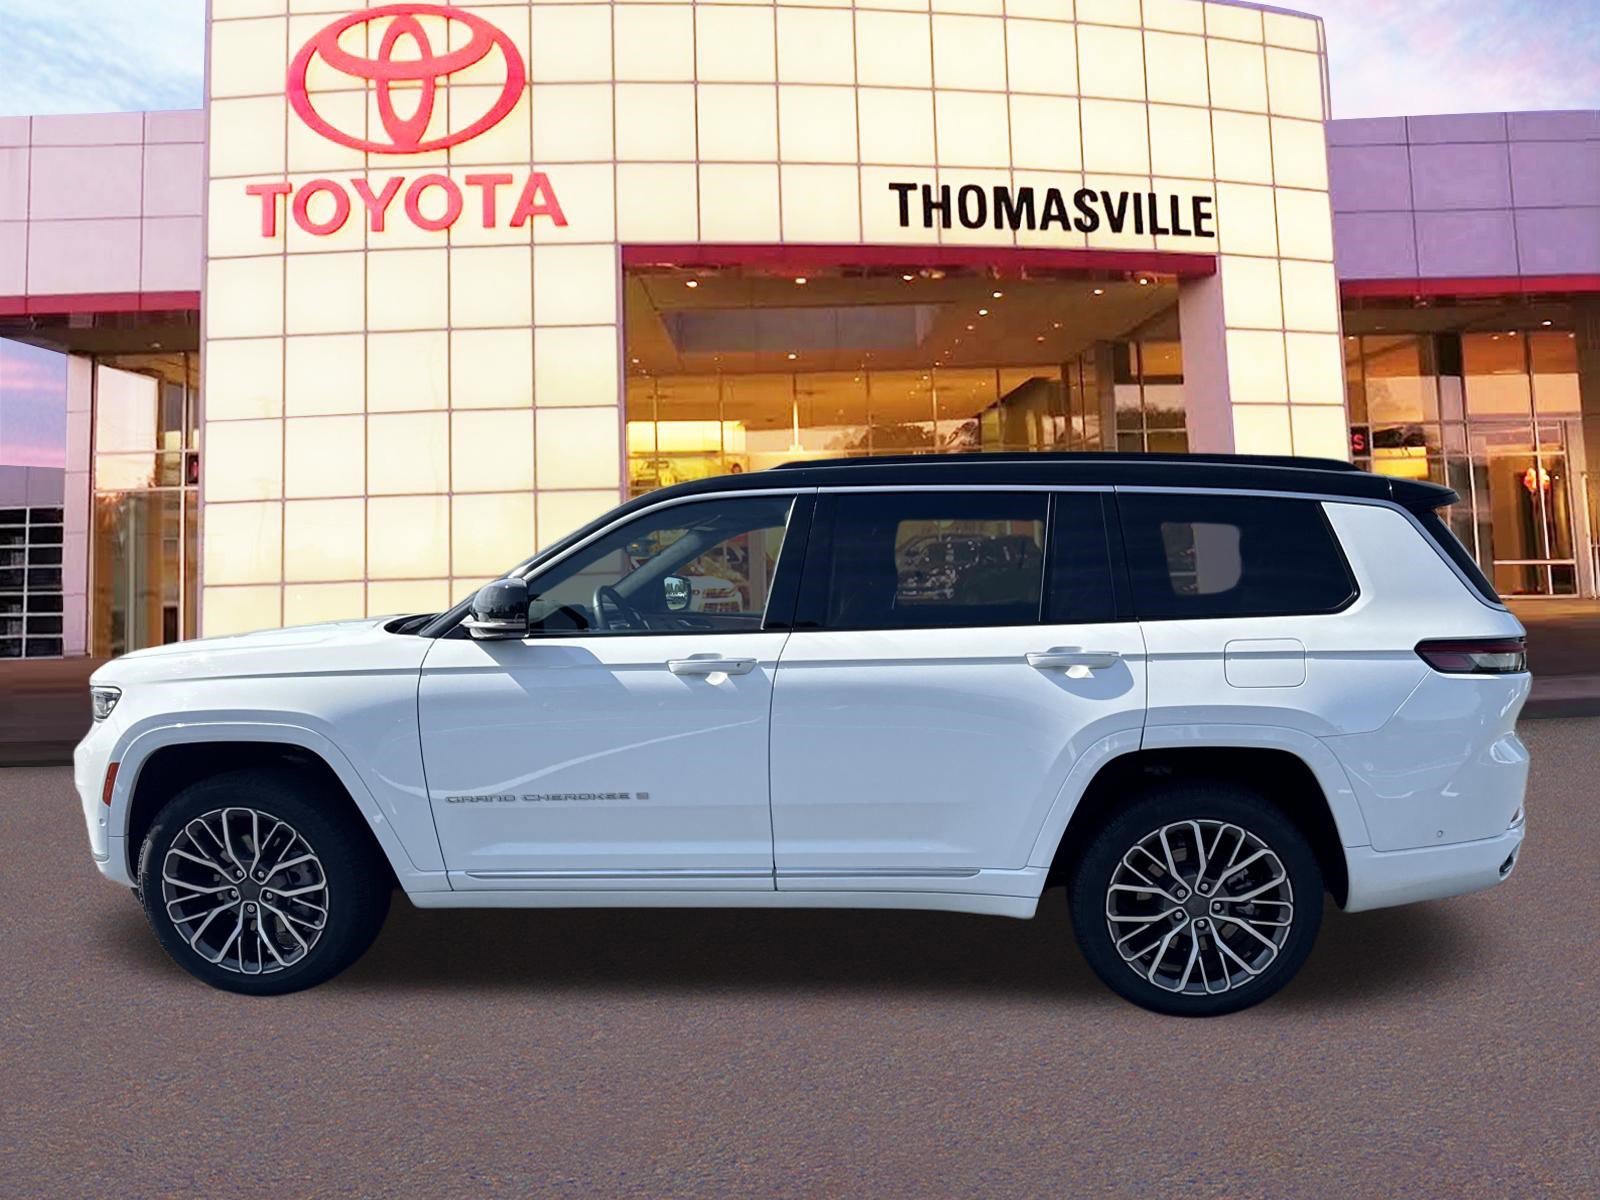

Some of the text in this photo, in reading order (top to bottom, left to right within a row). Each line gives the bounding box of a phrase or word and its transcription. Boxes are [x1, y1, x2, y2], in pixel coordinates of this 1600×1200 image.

[246, 172, 568, 237] TOYOTA
[889, 183, 1215, 237] THOMASVILLE
[446, 792, 631, 804] GRAND CHEROKEE
